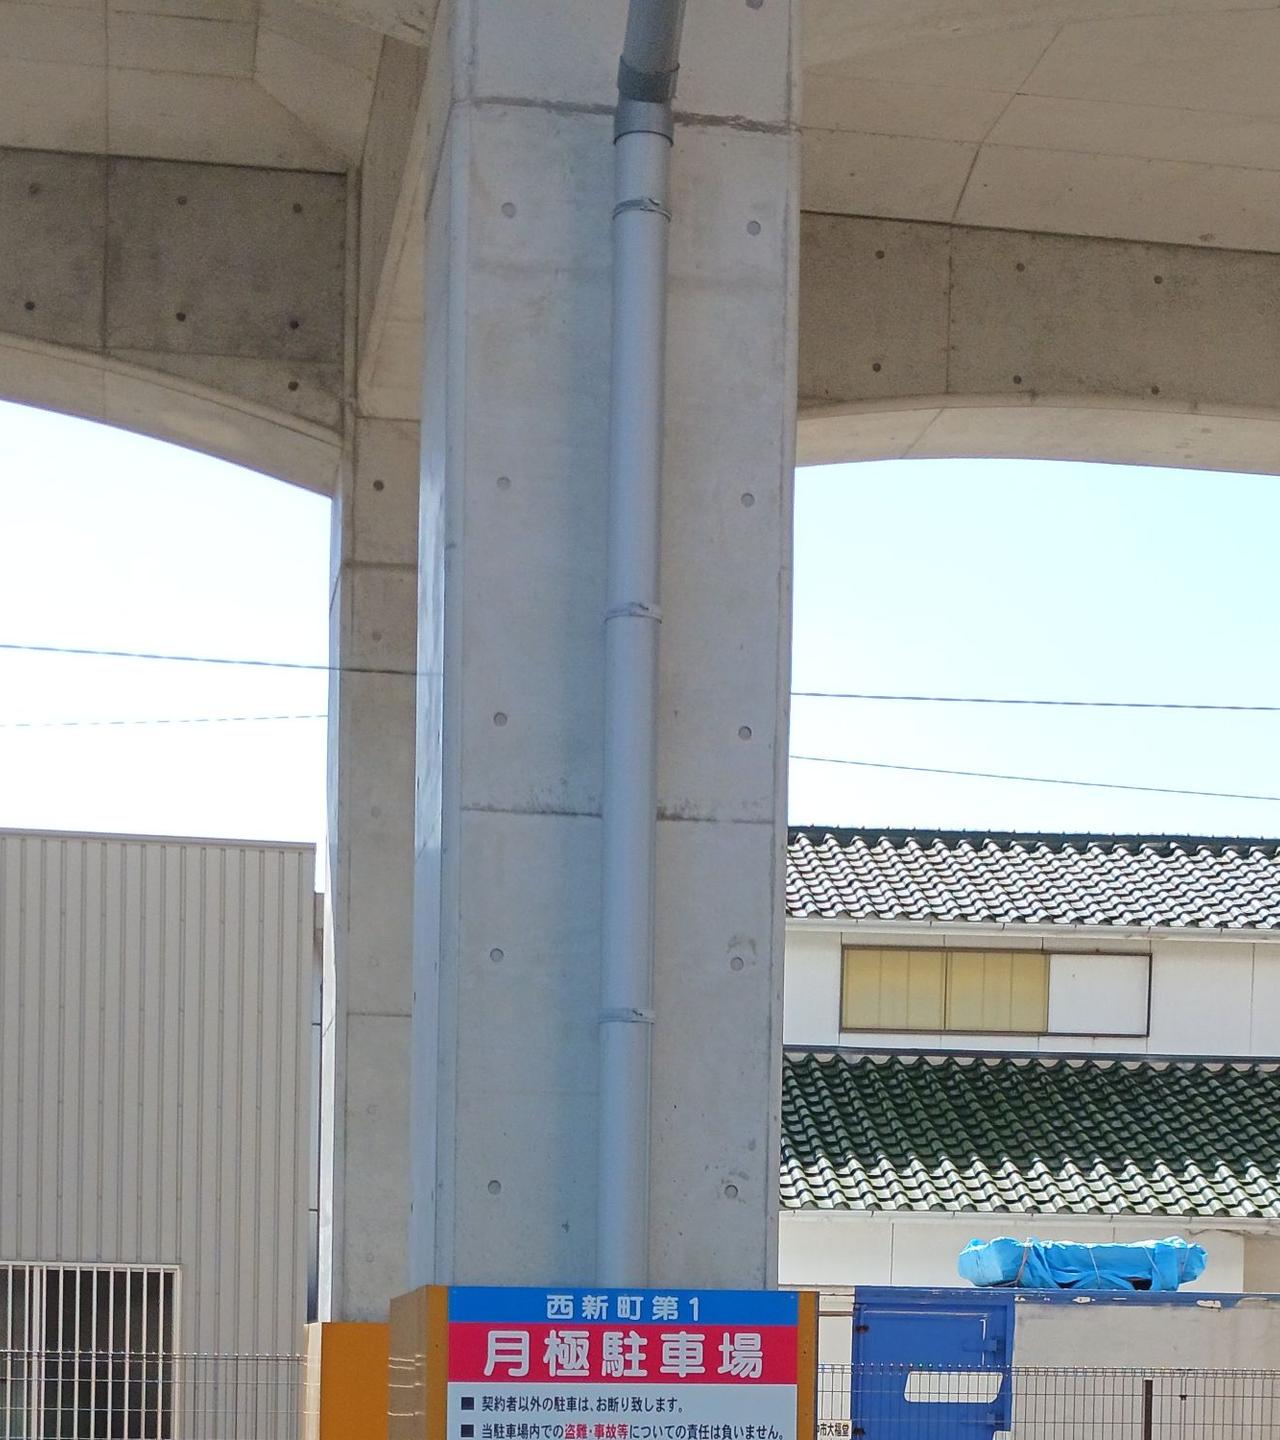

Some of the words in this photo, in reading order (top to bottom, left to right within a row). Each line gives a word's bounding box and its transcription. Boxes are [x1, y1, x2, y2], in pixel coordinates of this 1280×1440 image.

[546, 1294, 700, 1322] 西新町第1
[483, 1329, 763, 1379] 月極駐車場
[481, 1395, 683, 1413] 契約者以外の駐車は、お断り致します。
